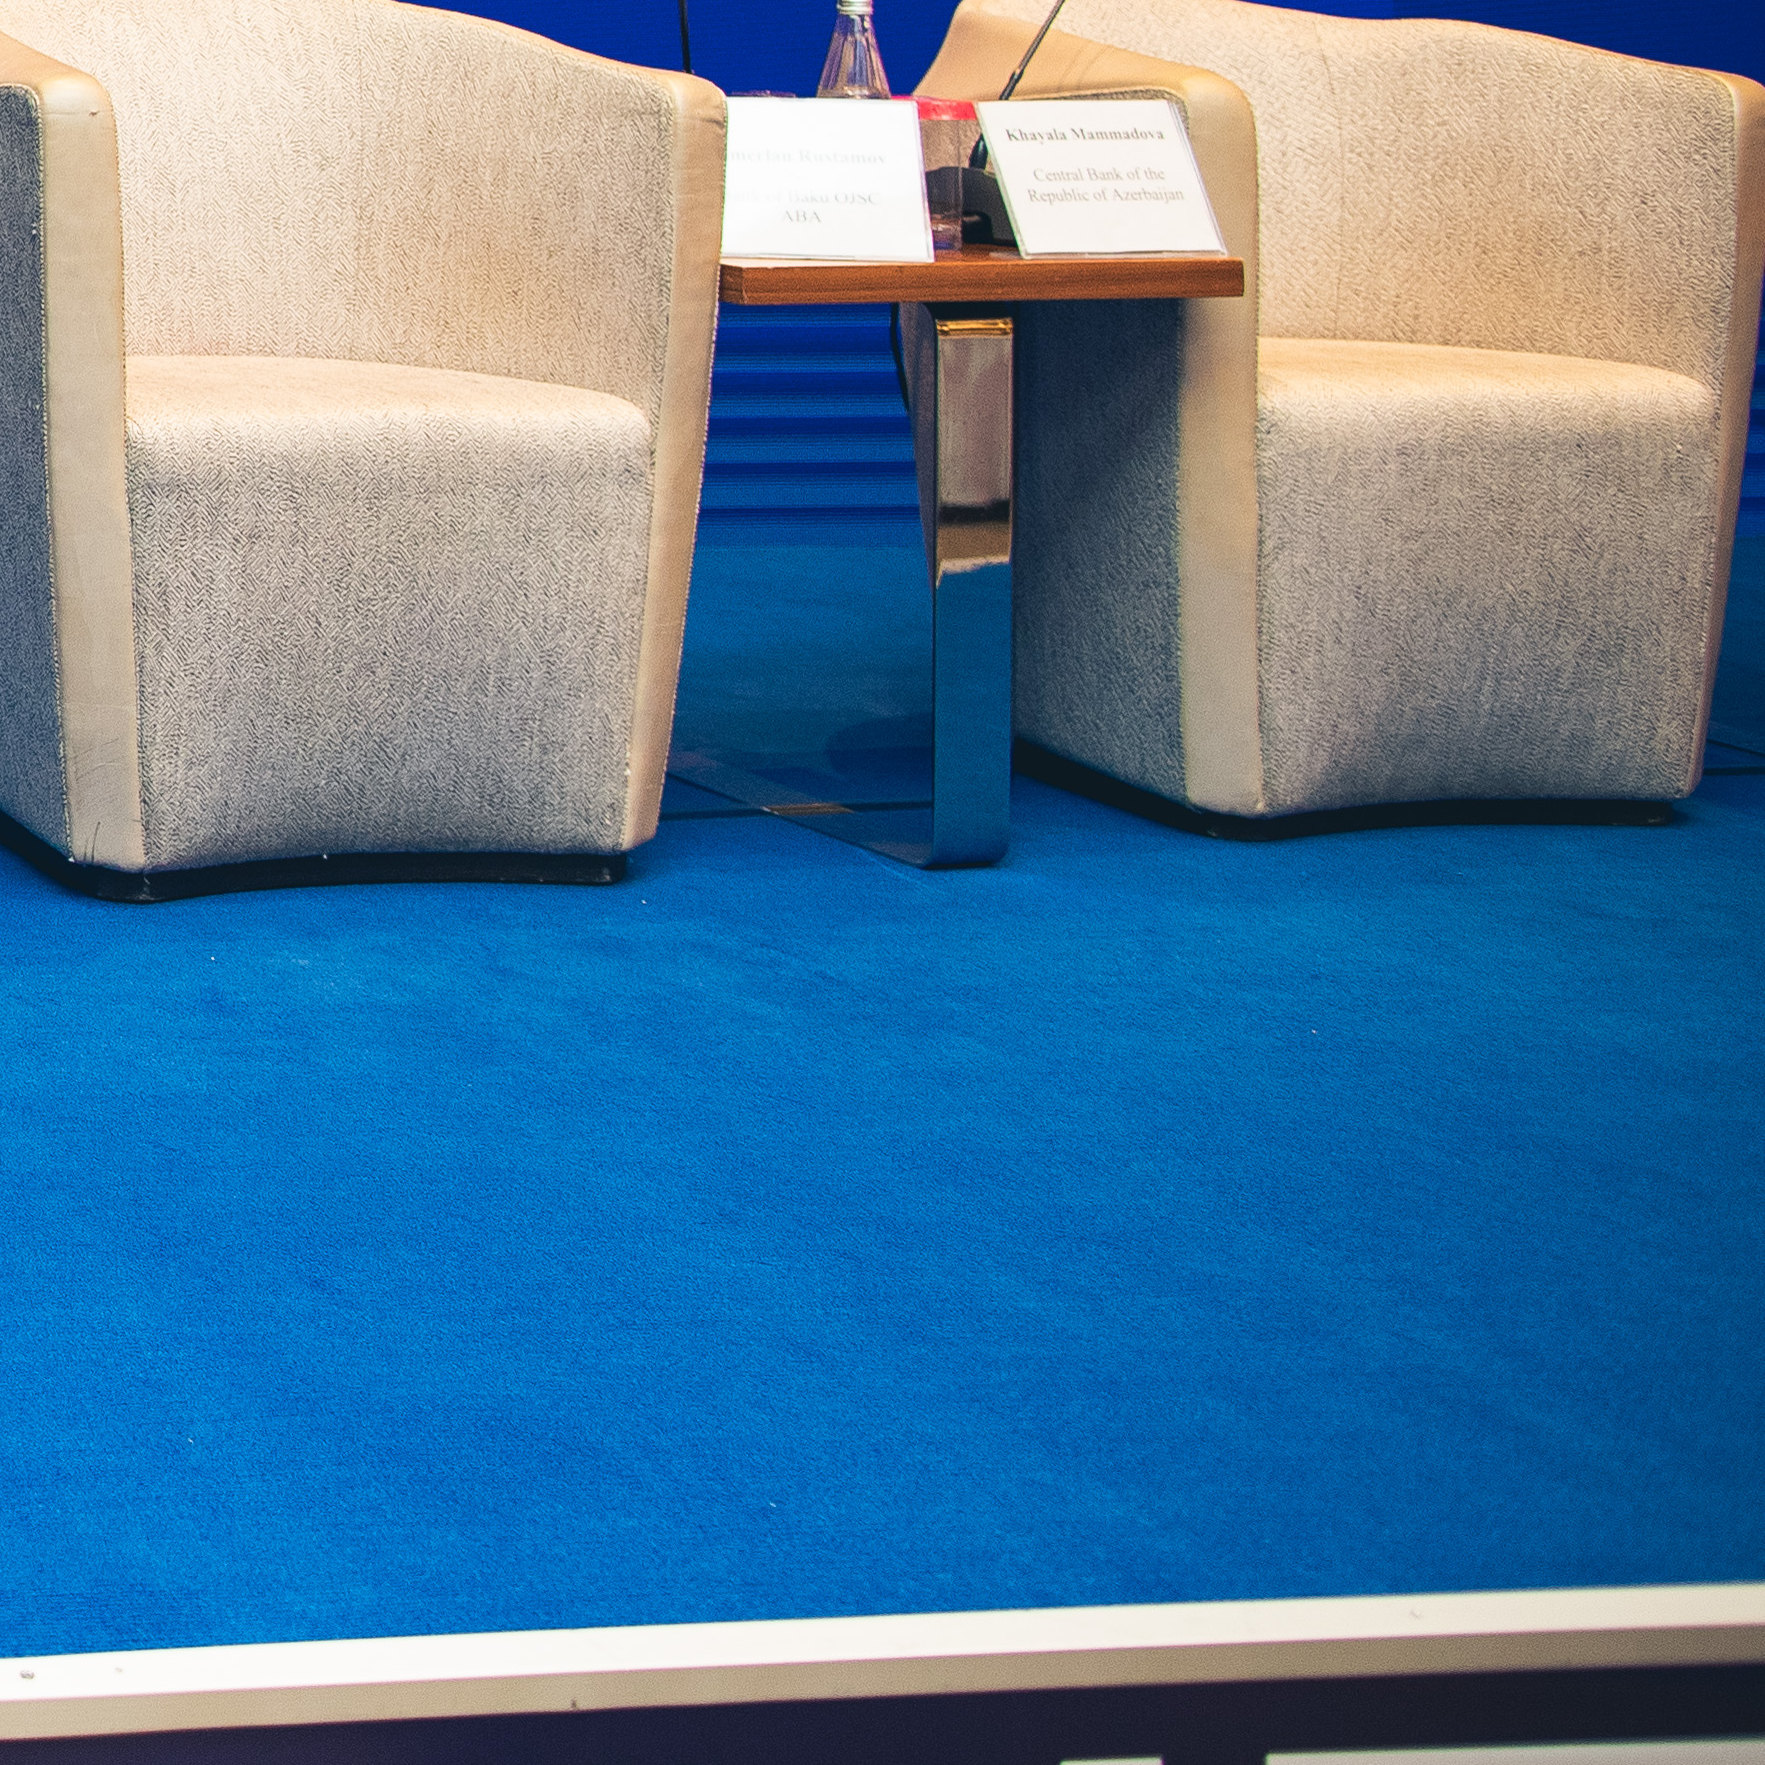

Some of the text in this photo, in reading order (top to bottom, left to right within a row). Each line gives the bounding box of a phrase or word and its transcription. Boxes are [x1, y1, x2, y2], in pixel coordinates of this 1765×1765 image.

[1005, 127, 1165, 145] Khayala Mammadova
[728, 148, 887, 165] merlan Rustamov
[1032, 167, 1166, 182] Central Bank of the
[788, 189, 830, 204] Baku
[833, 191, 881, 206] OJSC
[1027, 187, 1185, 205] Republic of Azerbaijan
[781, 209, 823, 224] ABA
